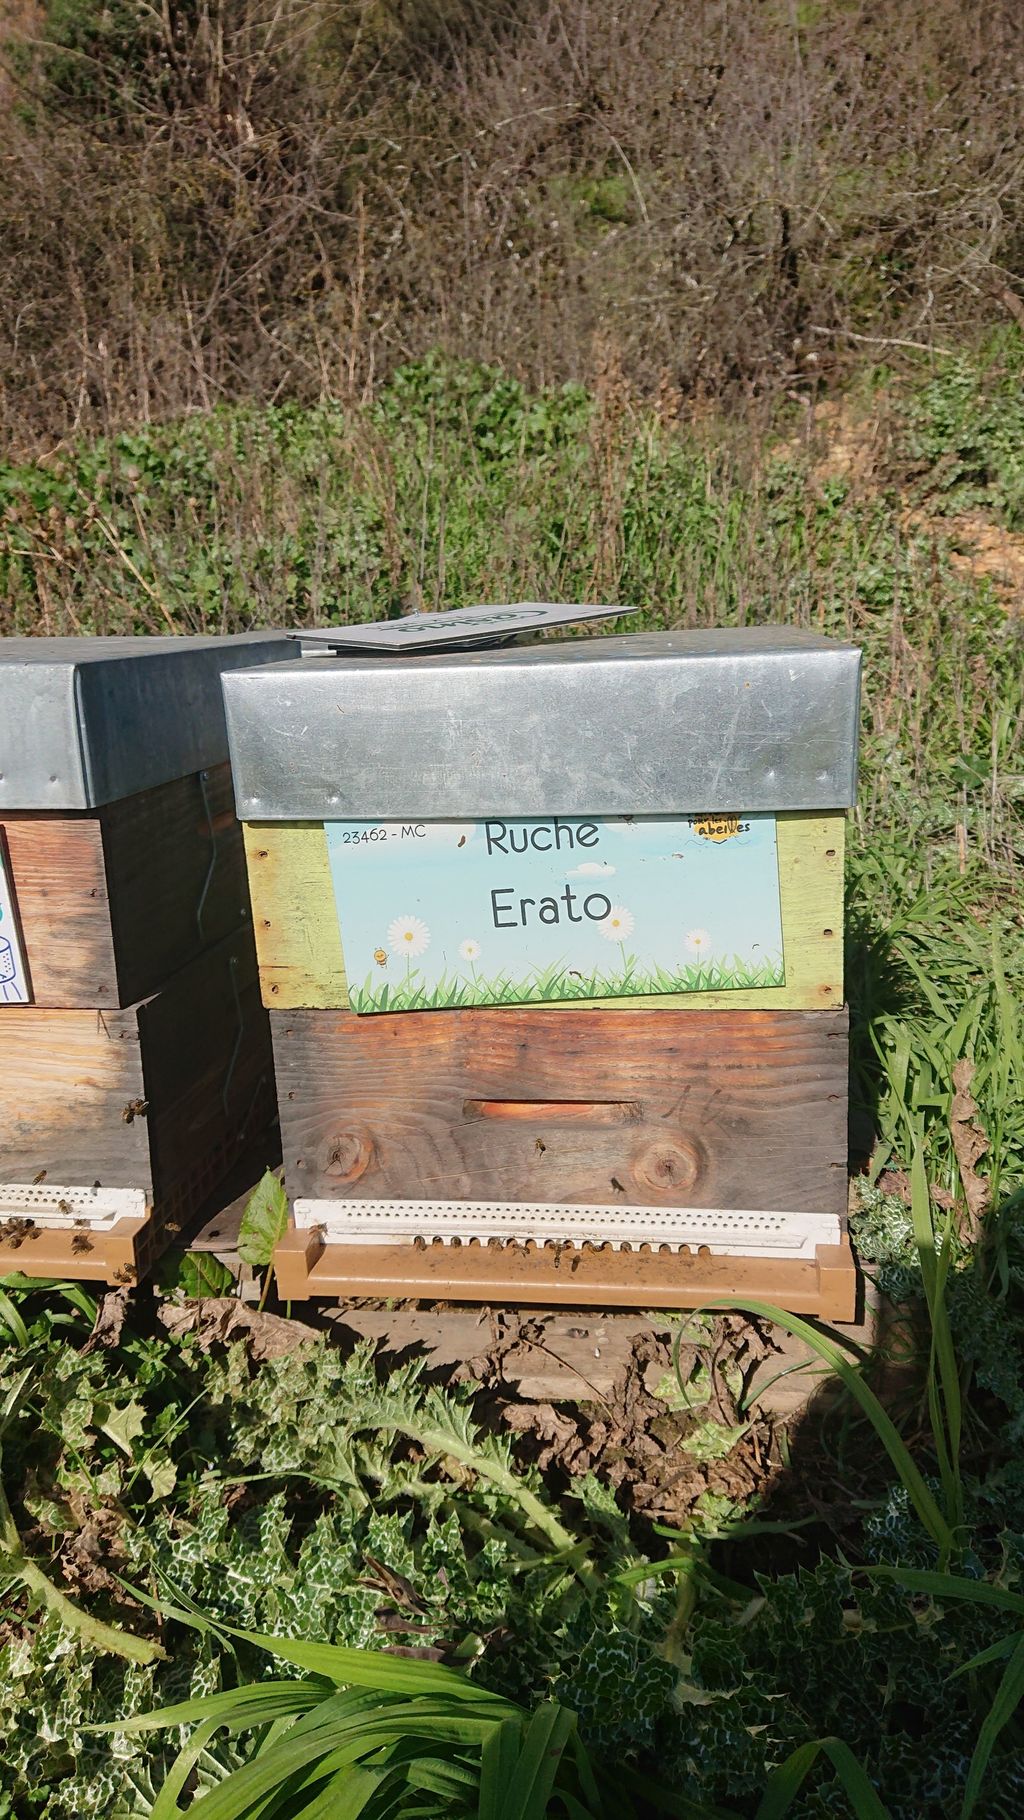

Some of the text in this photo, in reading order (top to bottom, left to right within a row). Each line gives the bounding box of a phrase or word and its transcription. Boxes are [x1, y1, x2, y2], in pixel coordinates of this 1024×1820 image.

[342, 828, 388, 844] 23462
[401, 824, 426, 839] MC
[486, 817, 599, 856] Ruche
[491, 885, 613, 928] Erato
